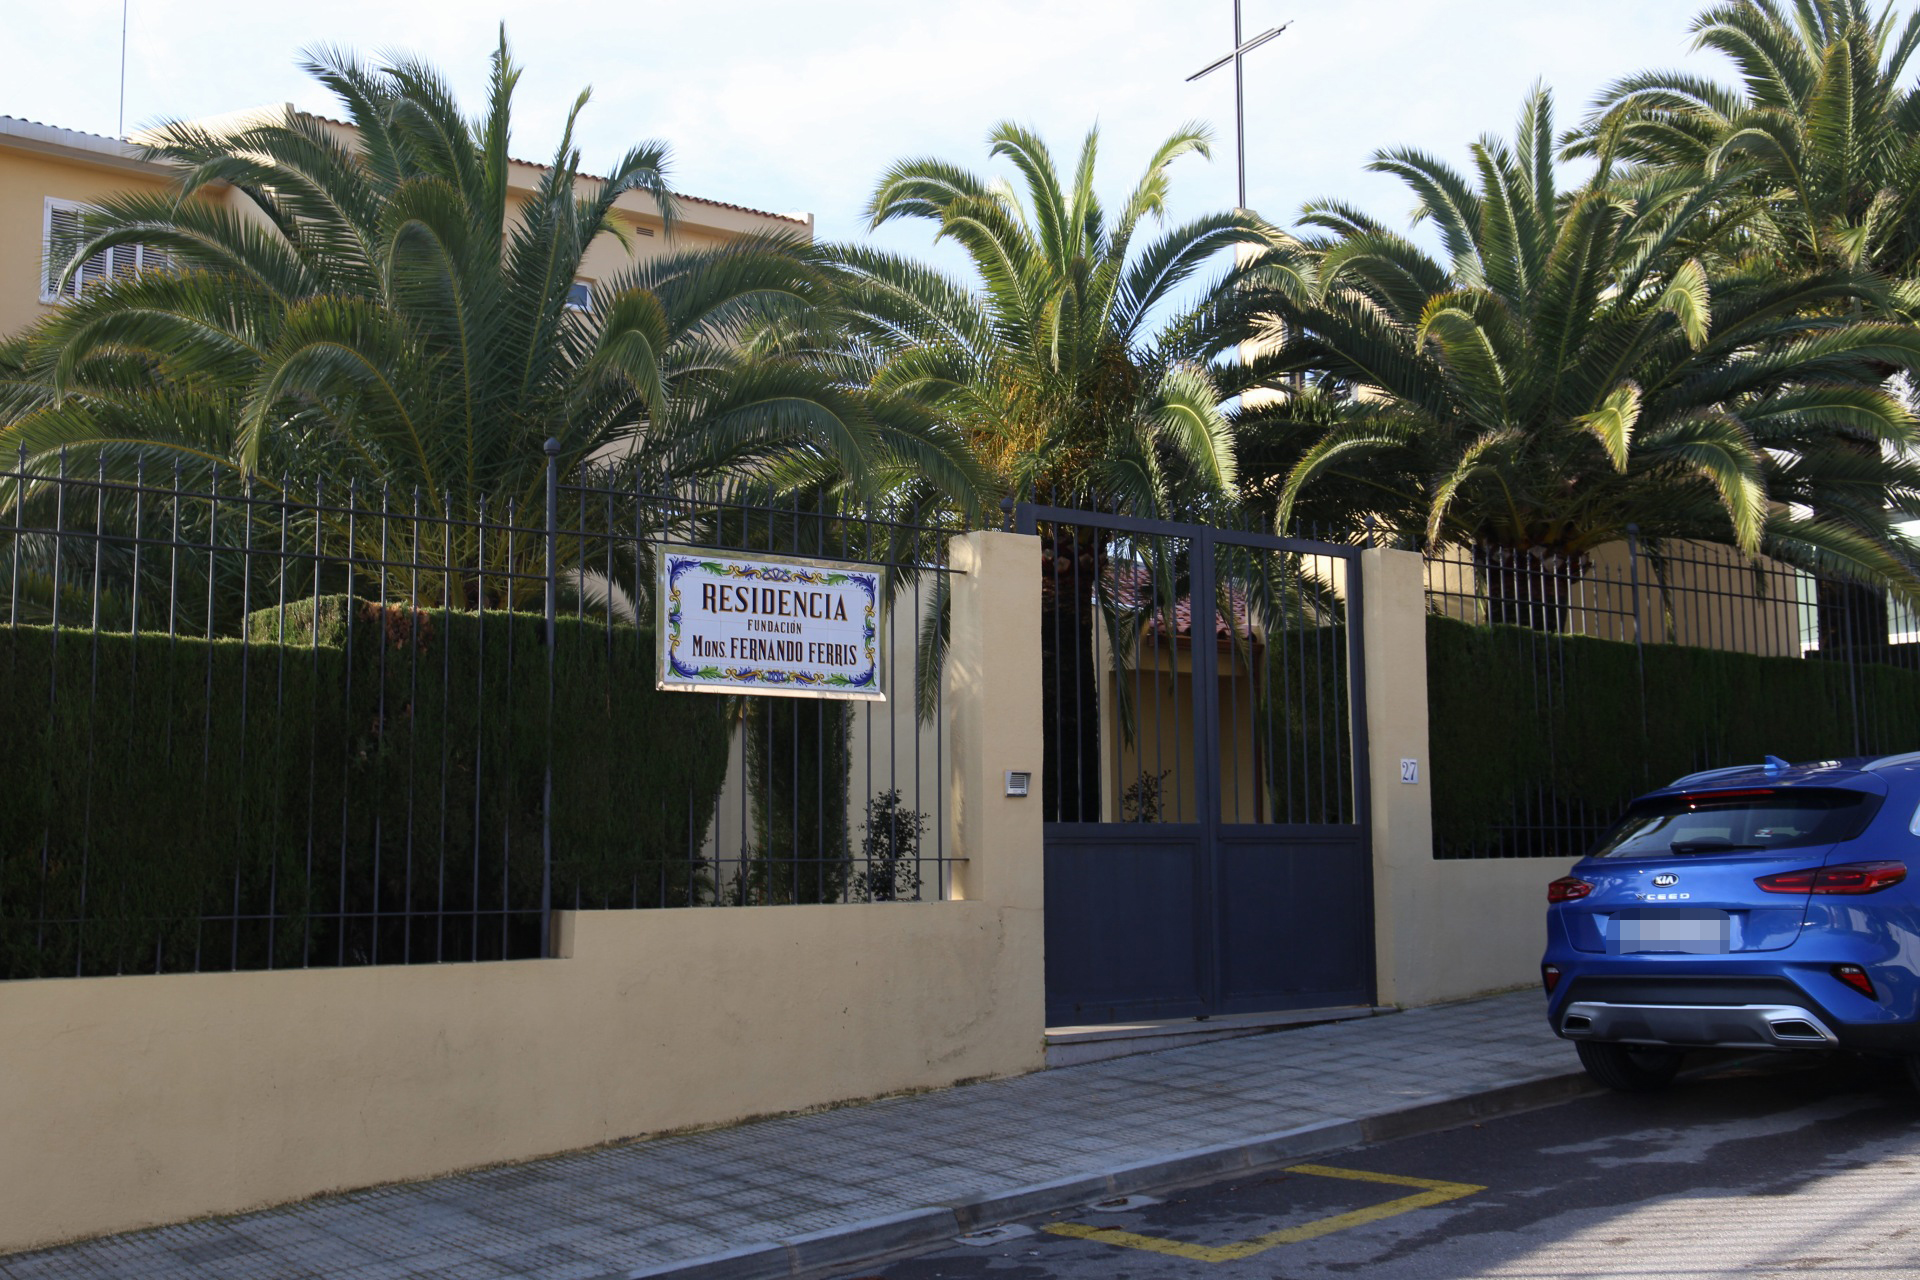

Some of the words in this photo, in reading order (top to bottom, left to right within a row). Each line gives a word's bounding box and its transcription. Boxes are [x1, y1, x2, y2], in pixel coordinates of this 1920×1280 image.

[702, 582, 849, 622] RESIDENCIA
[747, 618, 802, 635] FUNDACIÓN
[730, 637, 803, 663] FERNANDO
[808, 642, 858, 667] FERRIS
[1402, 761, 1417, 781] 27
[1655, 875, 1675, 885] KIA
